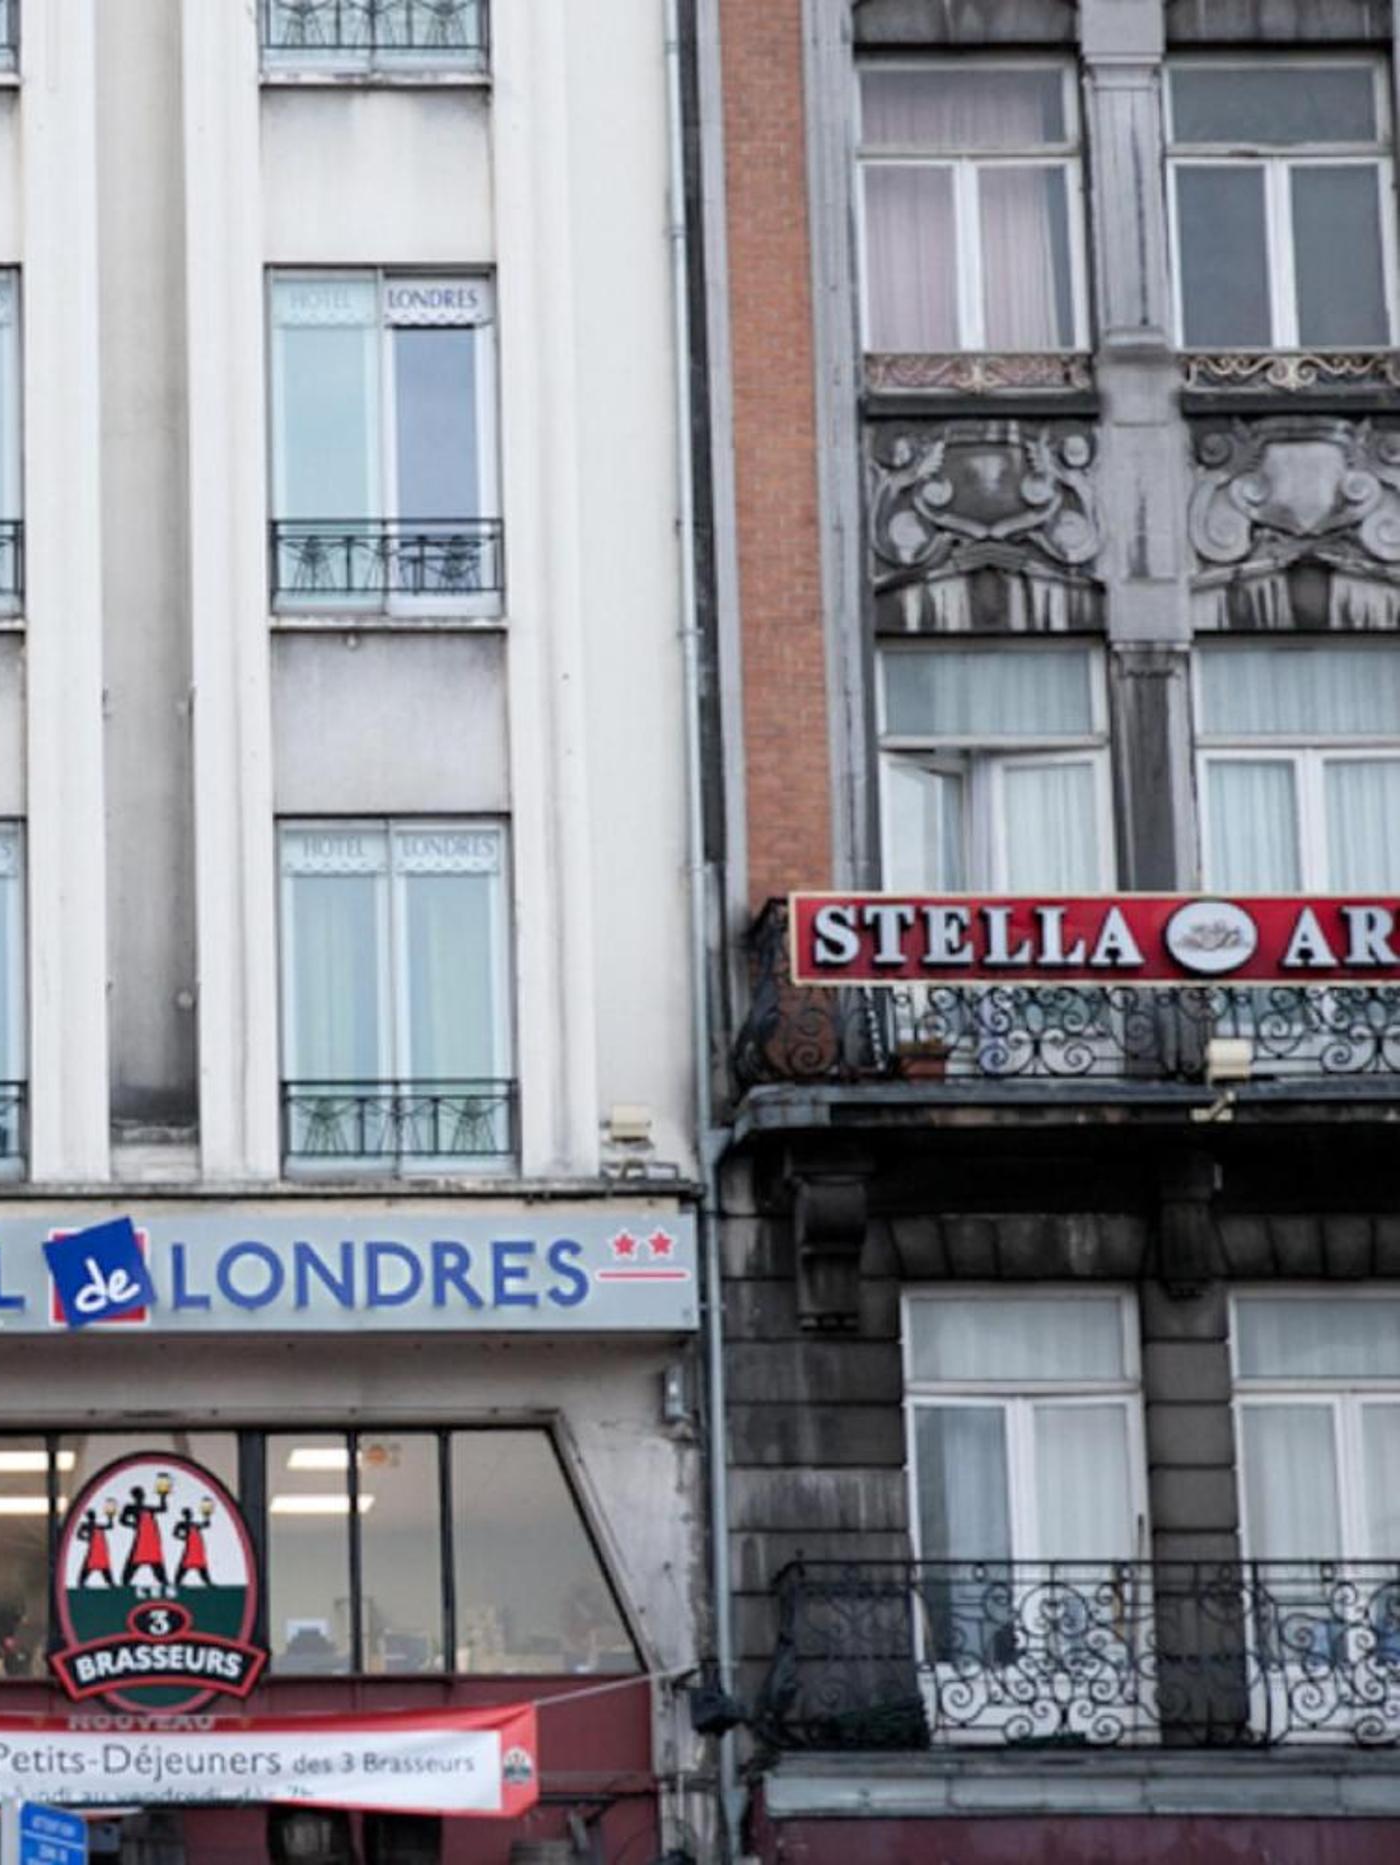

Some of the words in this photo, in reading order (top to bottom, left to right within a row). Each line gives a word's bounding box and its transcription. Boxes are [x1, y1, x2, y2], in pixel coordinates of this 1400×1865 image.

[387, 287, 480, 310] LONDRES
[302, 835, 366, 858] HOTEL
[812, 904, 1146, 968] STELLA
[74, 1257, 141, 1313] de
[170, 1238, 590, 1311] LONDRES
[149, 1609, 170, 1635] 3
[75, 1645, 243, 1683] BRASSEURS
[292, 1754, 333, 1775] des
[340, 1752, 356, 1774] 3
[363, 1752, 475, 1775] Brasseurs
